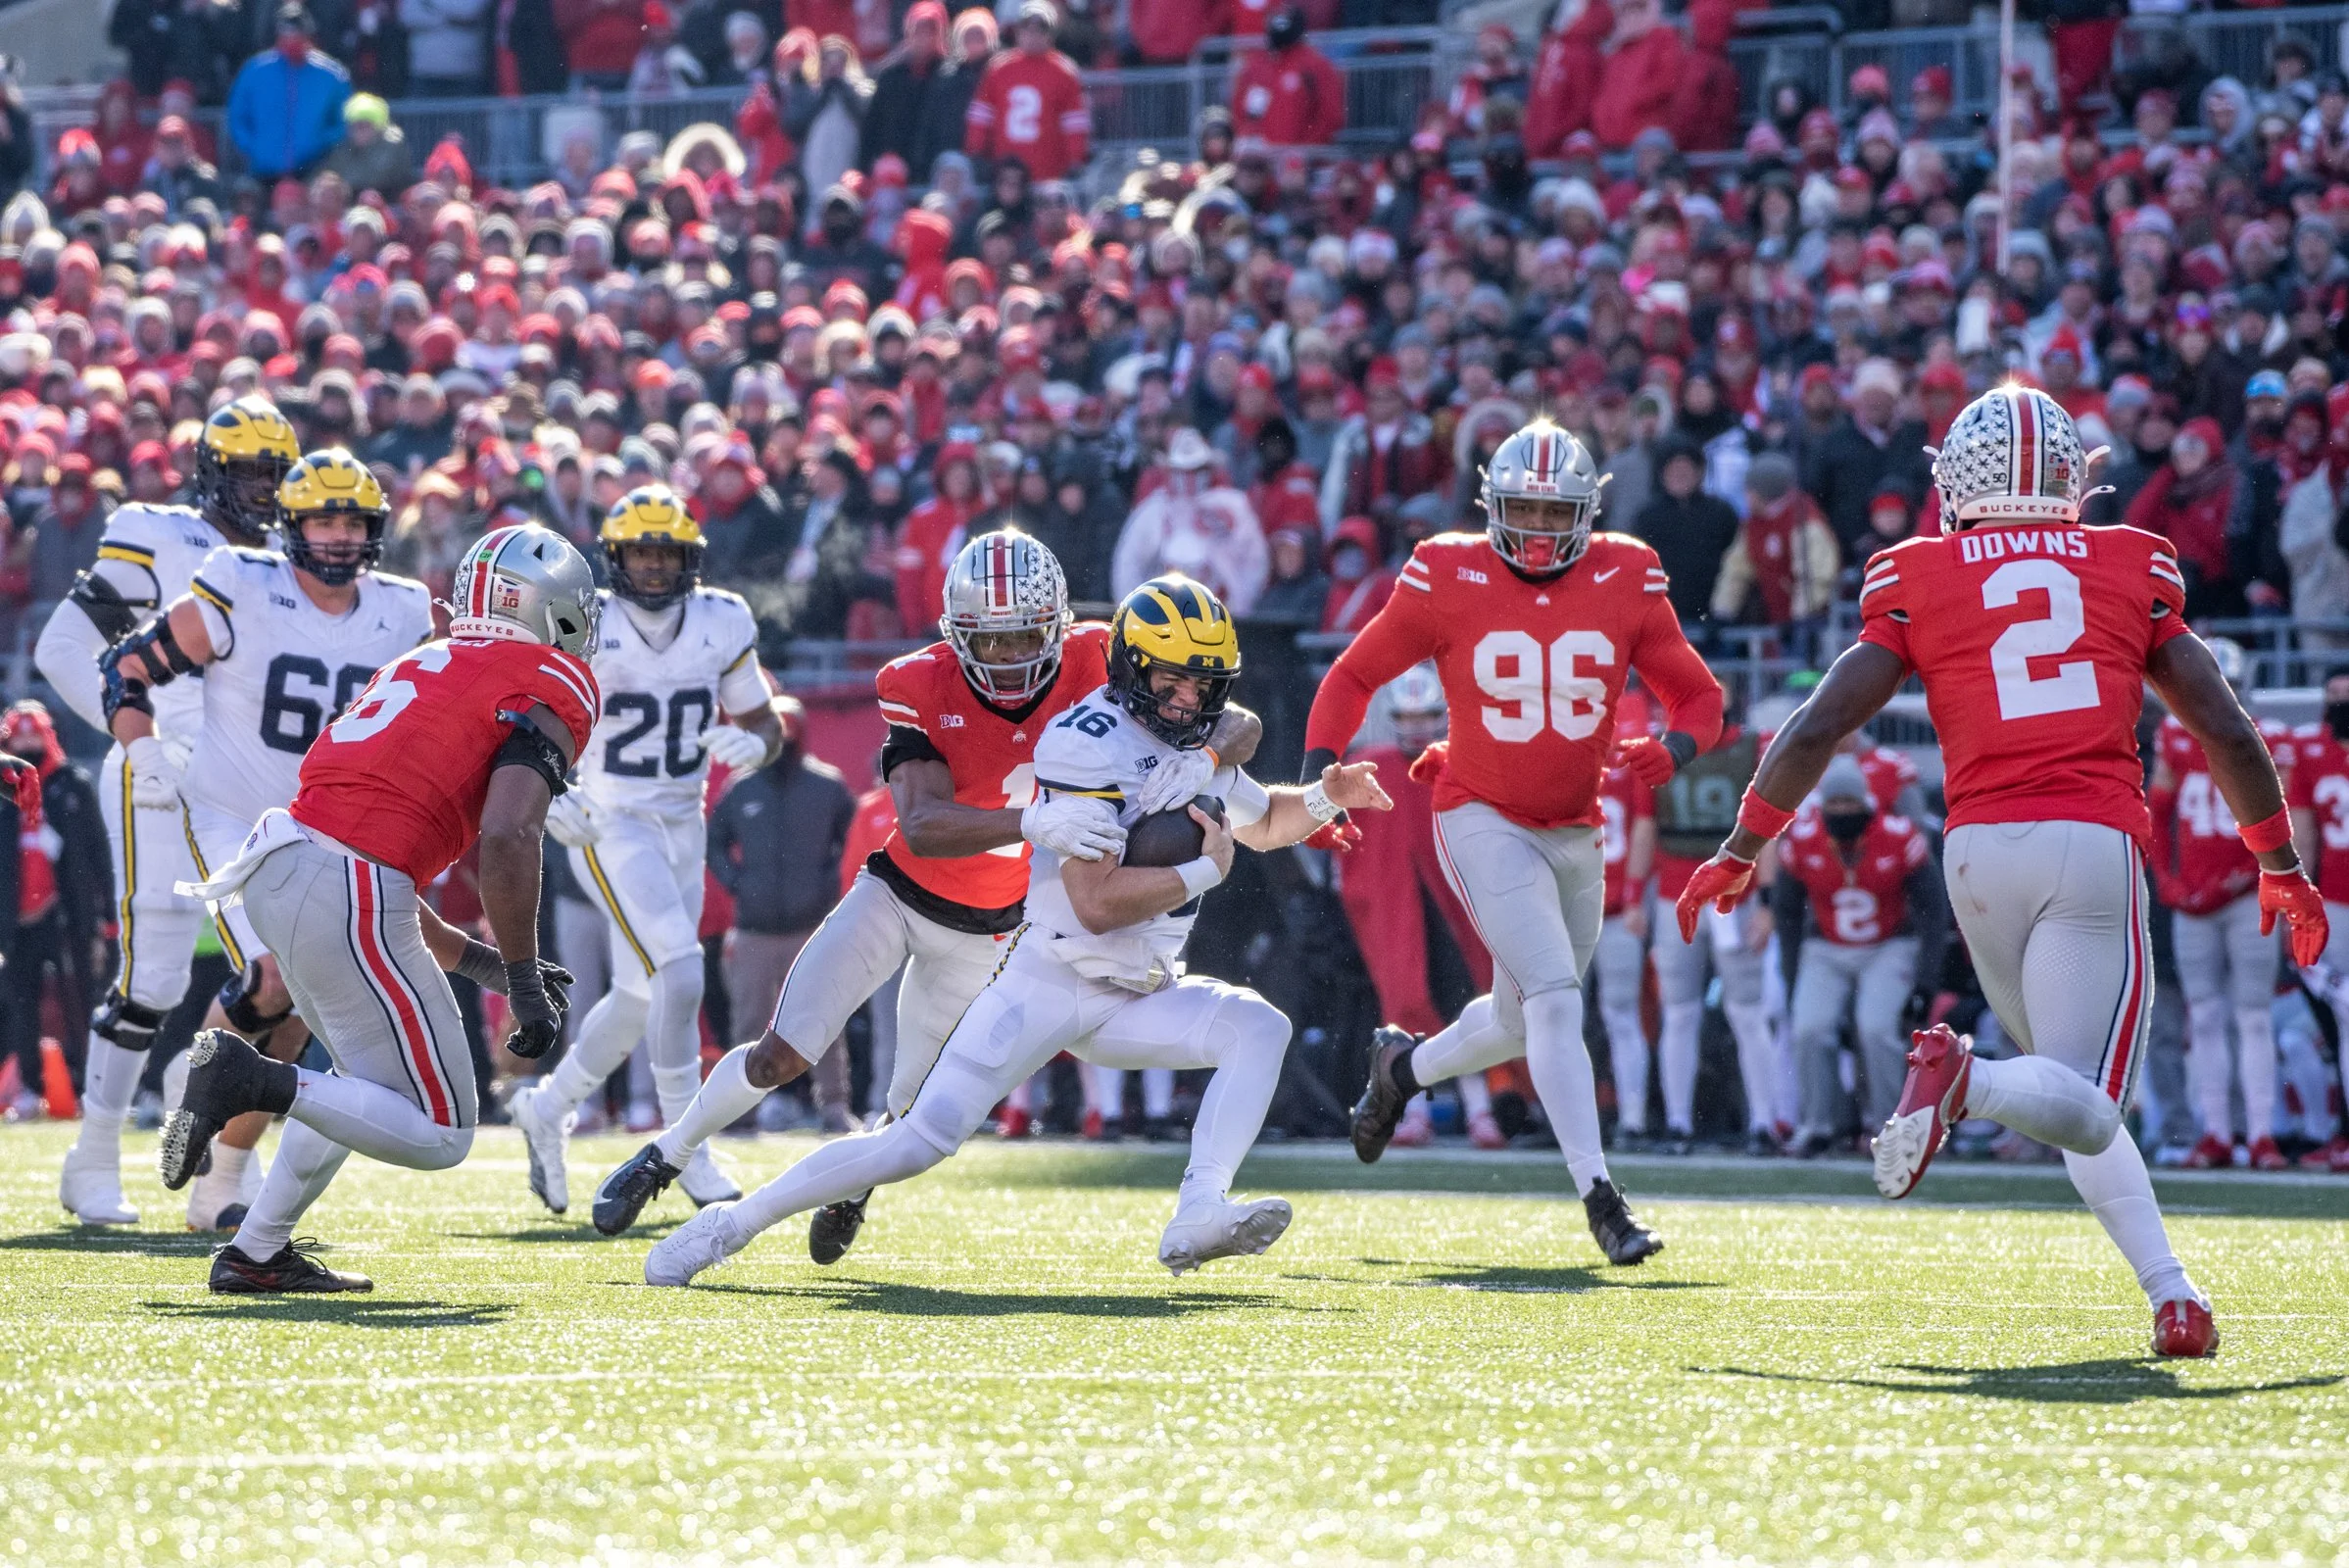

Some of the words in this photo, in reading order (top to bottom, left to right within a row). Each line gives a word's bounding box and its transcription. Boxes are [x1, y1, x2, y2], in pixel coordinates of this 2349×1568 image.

[1006, 84, 1041, 142] 2
[1979, 504, 2070, 515] BUCKEYES
[1961, 530, 2088, 564] DOWNS
[450, 624, 514, 636] BUCKEYES
[1982, 559, 2102, 721] 2
[329, 639, 453, 744] 6
[1473, 630, 1616, 744] 96
[604, 687, 712, 779] 20
[1055, 705, 1118, 739] 16
[1671, 773, 1736, 832] 19
